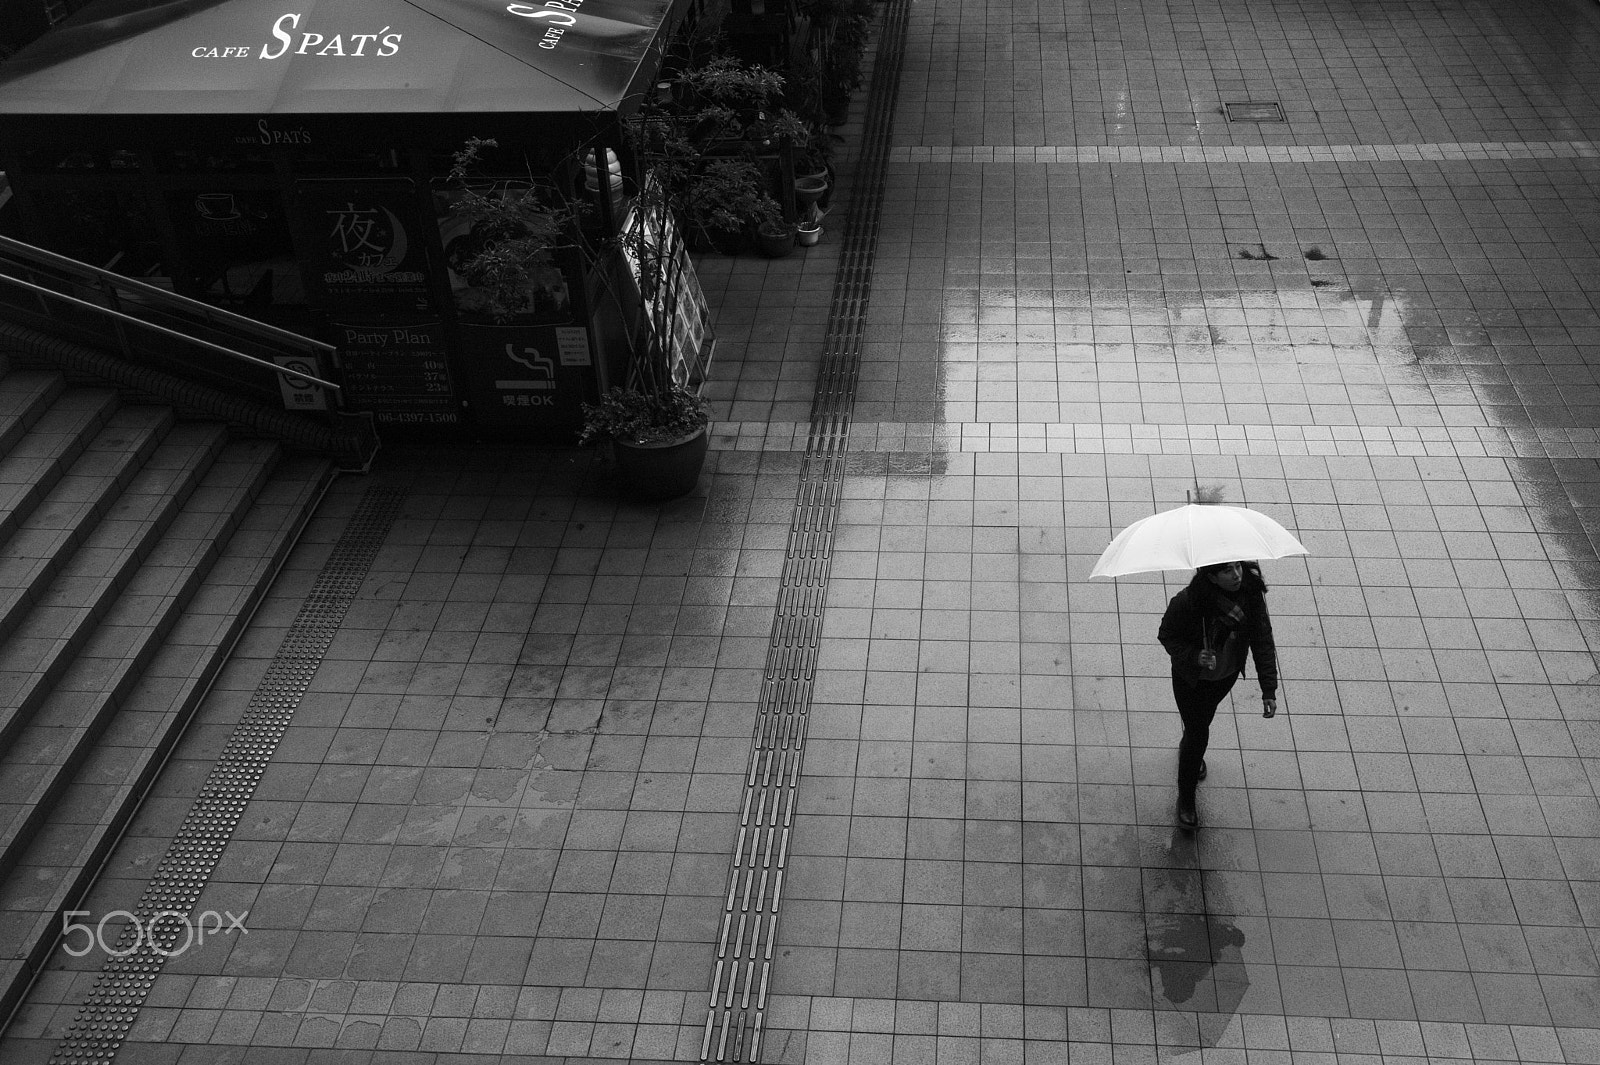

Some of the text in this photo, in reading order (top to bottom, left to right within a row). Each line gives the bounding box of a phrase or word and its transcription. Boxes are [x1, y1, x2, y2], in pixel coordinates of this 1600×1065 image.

[191, 13, 403, 60] CAFE SPAT'S
[538, 27, 565, 50] CAFE
[326, 202, 386, 253] 夜
[358, 252, 397, 267] カフェ
[345, 329, 431, 348] Party Plan
[378, 412, 457, 423] 06-4397-1500
